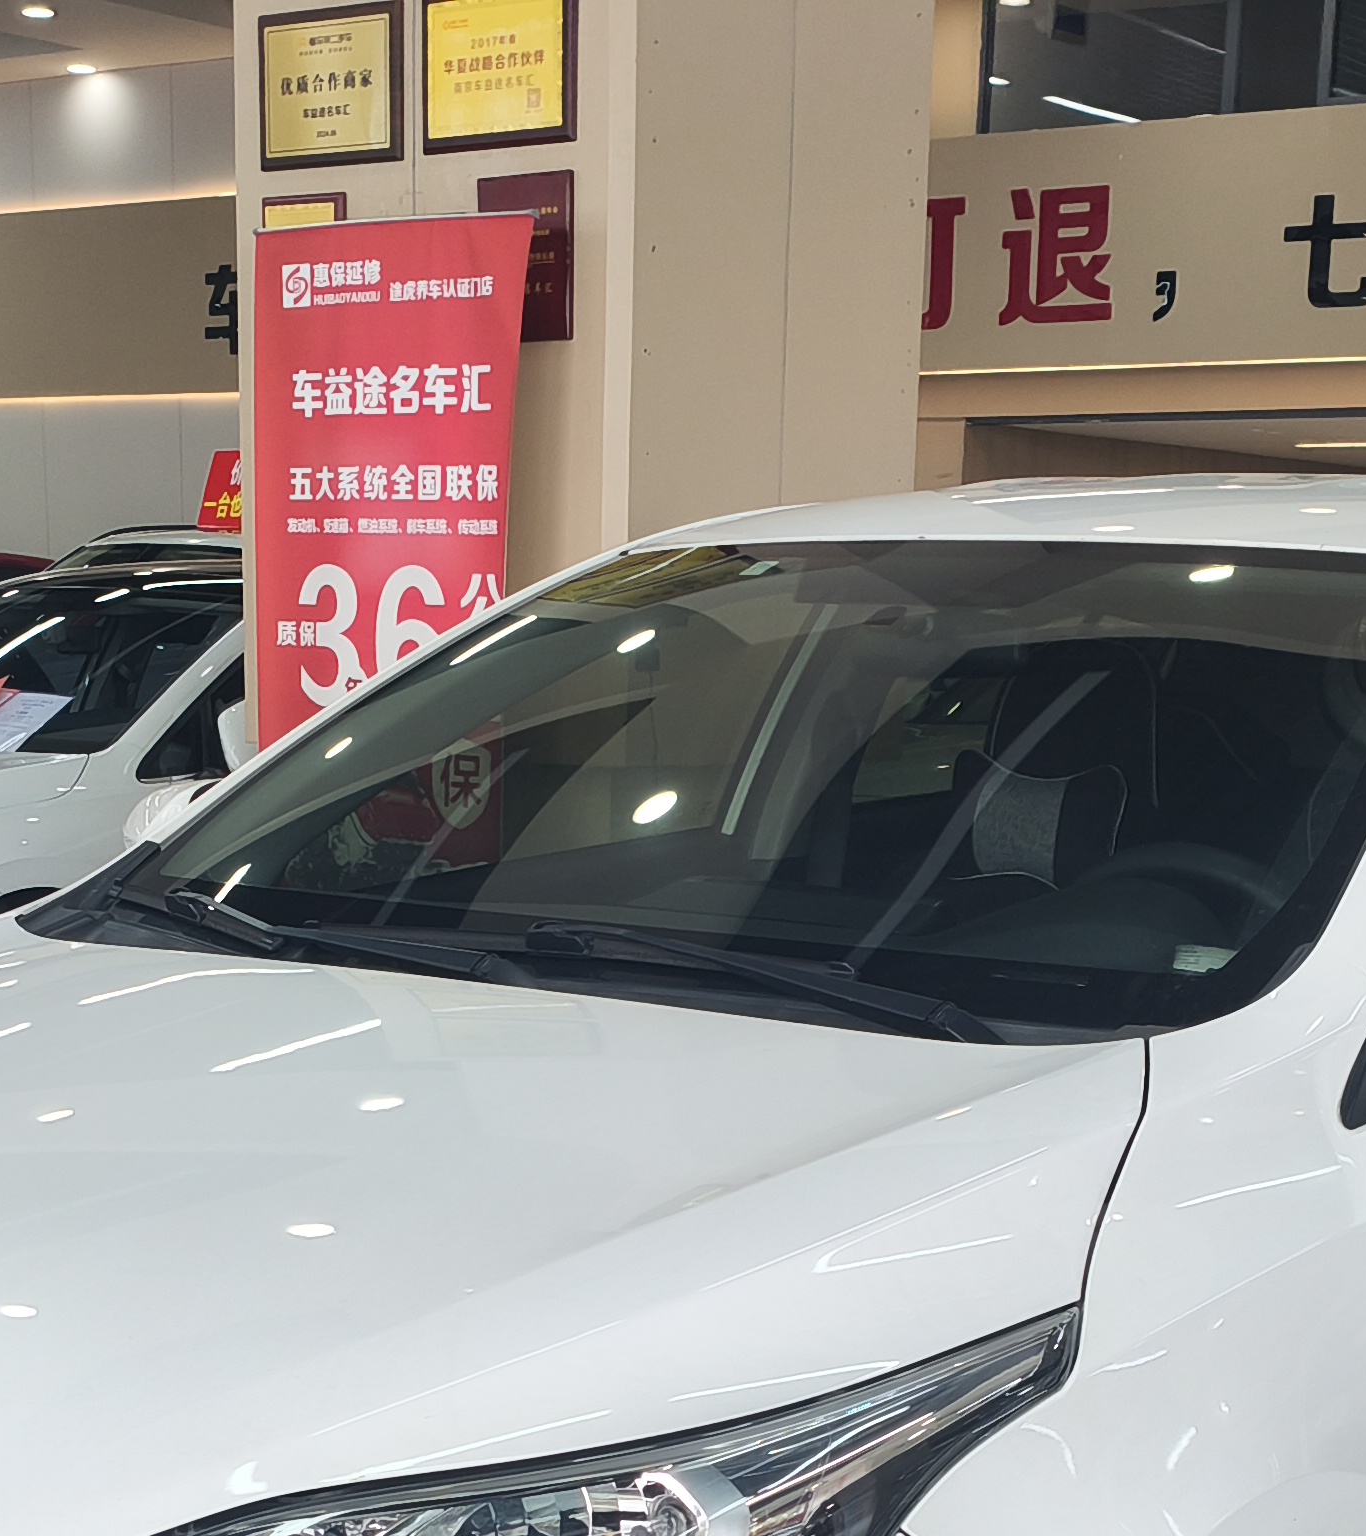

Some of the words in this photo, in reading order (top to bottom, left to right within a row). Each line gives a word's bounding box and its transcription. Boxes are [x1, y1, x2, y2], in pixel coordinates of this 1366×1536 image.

[281, 69, 373, 96] 优质合作商家
[312, 259, 381, 288] 惠保延修
[389, 275, 494, 302] 途虎养车认证门店
[292, 363, 492, 418] 车益途名车汇
[289, 464, 498, 501] 五大系统全国联保
